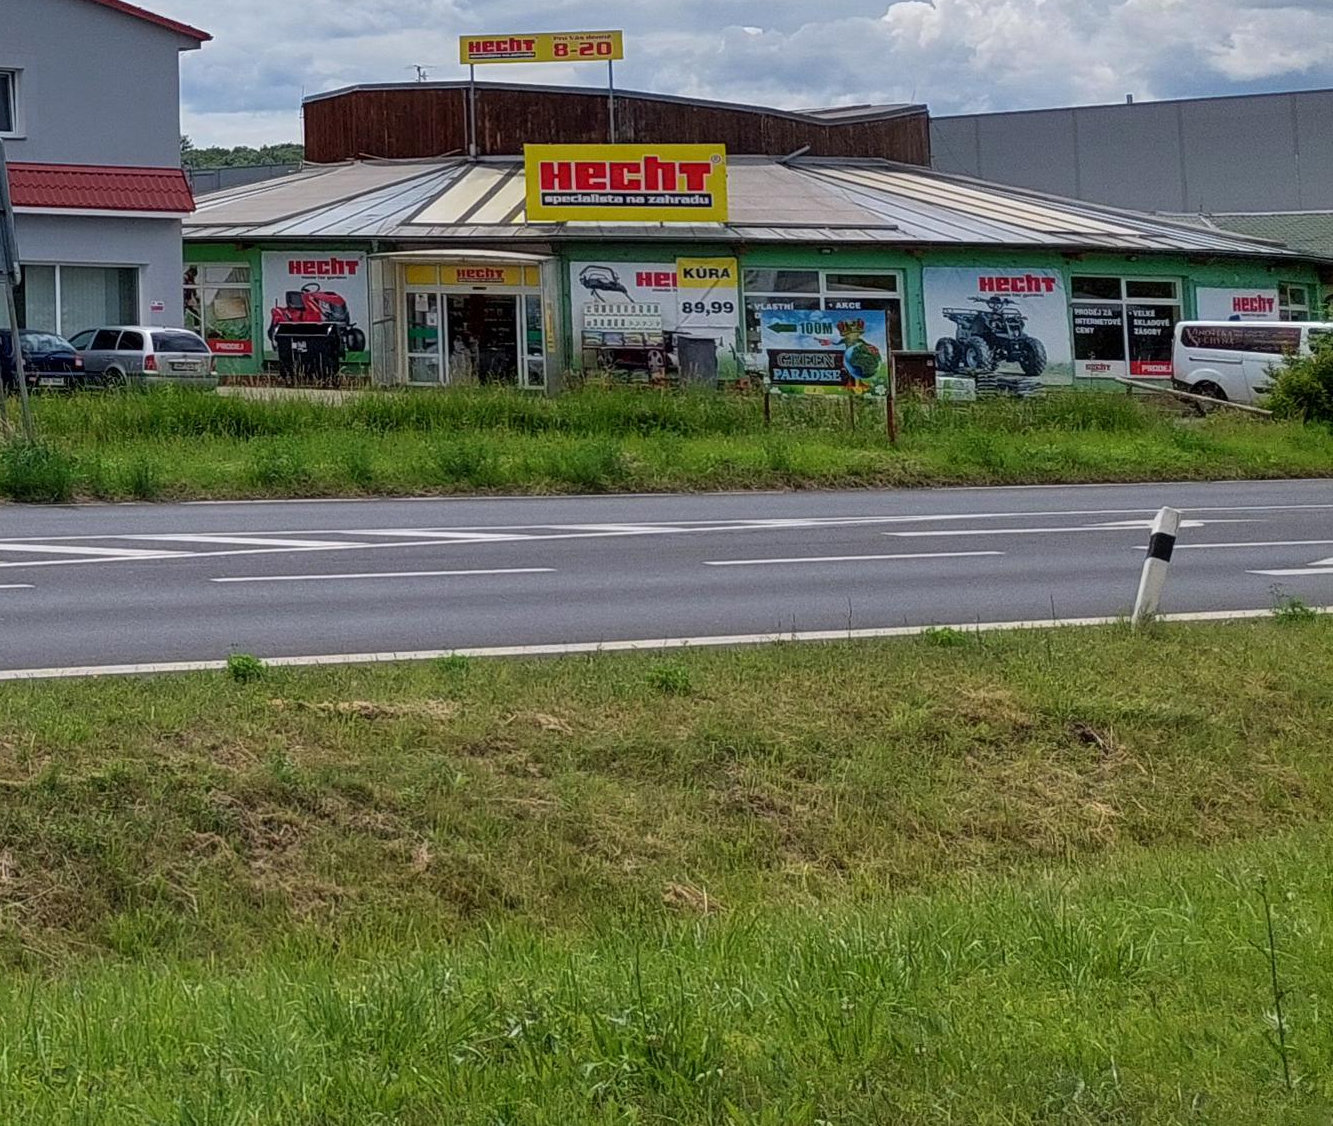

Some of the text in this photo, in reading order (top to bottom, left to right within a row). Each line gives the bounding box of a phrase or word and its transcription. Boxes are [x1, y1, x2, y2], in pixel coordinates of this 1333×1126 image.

[553, 41, 612, 57] 8-20
[544, 193, 710, 205] specialista na zahradu
[682, 301, 734, 317] 89,99
[754, 302, 794, 310] VLASTNÍ
[1103, 308, 1112, 316] ZA
[800, 322, 833, 334] 100M
[777, 353, 836, 368] GREEN
[773, 368, 842, 382] PARADISE
